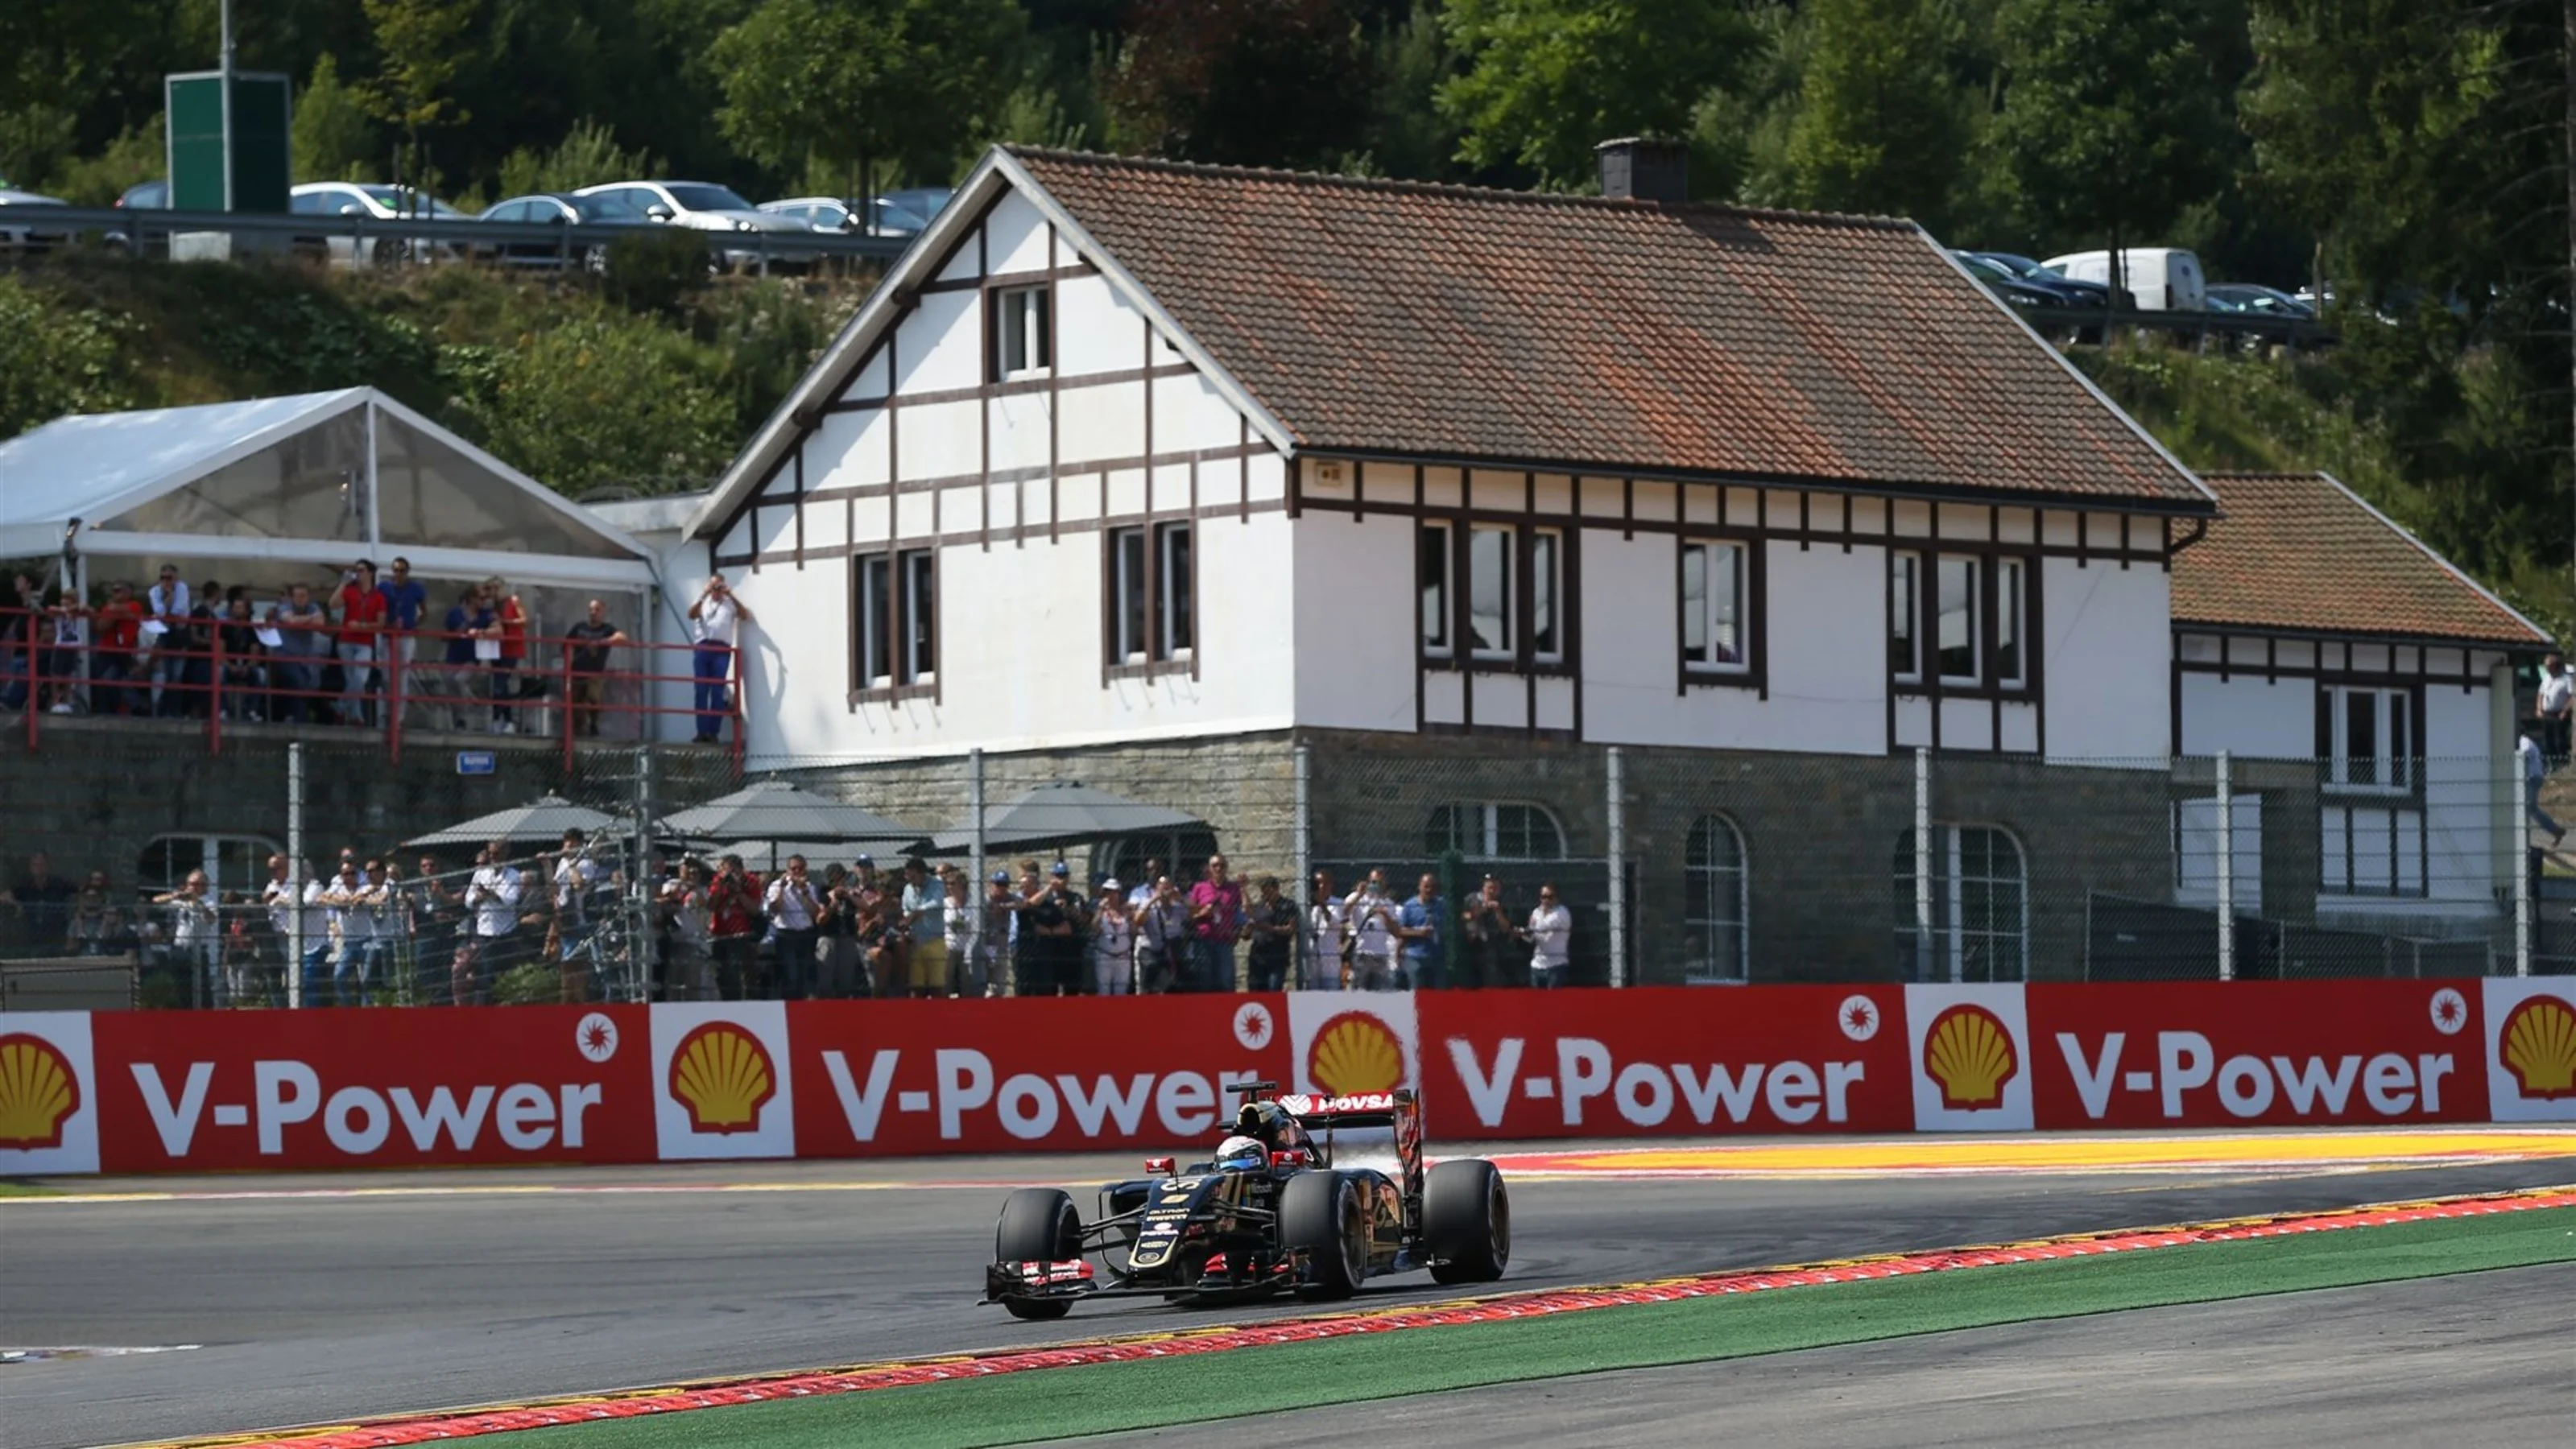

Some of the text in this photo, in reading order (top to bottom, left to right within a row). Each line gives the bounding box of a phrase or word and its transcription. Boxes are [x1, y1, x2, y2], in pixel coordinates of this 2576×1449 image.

[129, 1059, 602, 1157] V-Power
[822, 1049, 1258, 1140] V-Power
[1447, 1038, 1864, 1125] V-Power
[2057, 1032, 2454, 1117] V-Power
